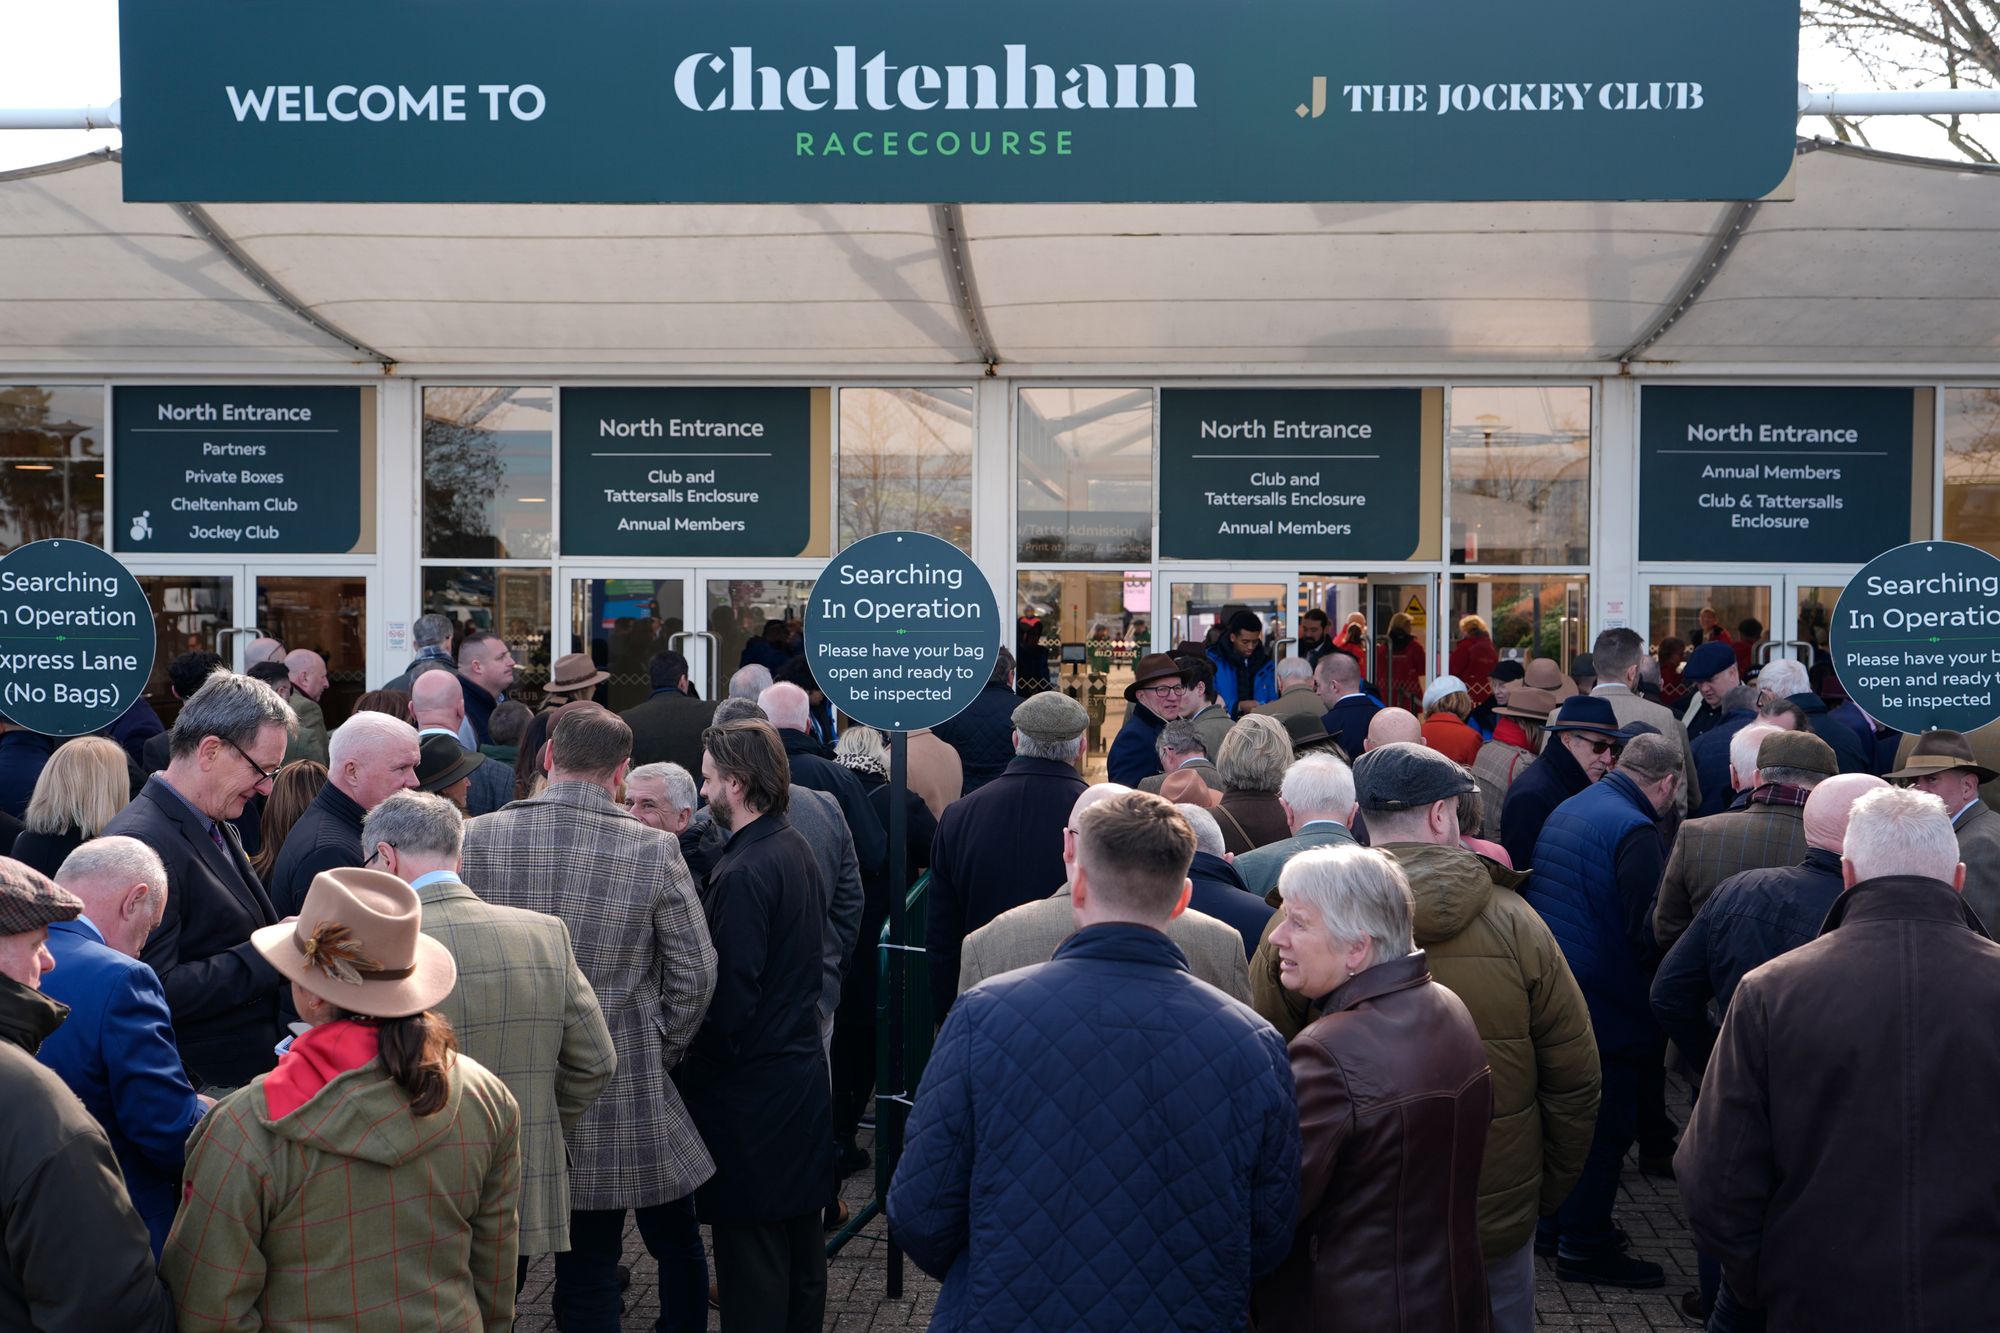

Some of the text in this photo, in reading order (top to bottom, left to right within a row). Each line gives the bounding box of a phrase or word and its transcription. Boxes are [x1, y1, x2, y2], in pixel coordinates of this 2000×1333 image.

[674, 44, 1197, 111] Cheltenham
[226, 84, 545, 121] WELCOME TO
[1343, 82, 1703, 115] THE JOCKEY CLUB
[797, 131, 1072, 156] RACECOURSE
[159, 403, 311, 421] North Entrance
[600, 418, 764, 437] North Entrance
[1202, 419, 1372, 438] North Entrance
[1688, 424, 1858, 443] North Entrance
[203, 442, 266, 455] Partners
[186, 470, 284, 483] Private Boxes
[648, 470, 714, 483] Club and
[1251, 472, 1319, 486] Club and
[1702, 464, 1841, 479] Annual Members
[171, 497, 298, 511] Cheltenham Club
[604, 489, 759, 502] Tattersalls Enclosure
[1205, 492, 1365, 505] Tattersalls Enclosure
[1699, 493, 1843, 509] Club & Tattersalls
[617, 517, 745, 531] Annual Members
[1218, 521, 1351, 534] Annual Members
[1732, 514, 1809, 528] Enclosure
[189, 525, 279, 541] Jockey Club
[1068, 524, 1137, 537] Admission
[2, 571, 117, 597] Searching
[841, 564, 962, 589] Searching
[1867, 572, 1998, 596] Searching
[15, 605, 135, 629] Operation
[823, 598, 980, 623] In Operation
[1849, 610, 1874, 629] In
[819, 643, 984, 660] Please have your bag
[1847, 653, 1899, 666] Please
[1905, 652, 1944, 665] have
[1948, 653, 1987, 667] your
[0, 651, 137, 673] xpress Lane
[829, 665, 973, 681] open and ready to
[1859, 677, 1900, 689] open
[1906, 672, 1937, 686] and
[1943, 671, 1991, 687] ready
[5, 682, 119, 708] (No Bags)
[851, 687, 951, 703] be inspected
[1882, 692, 1990, 709] be inspected
